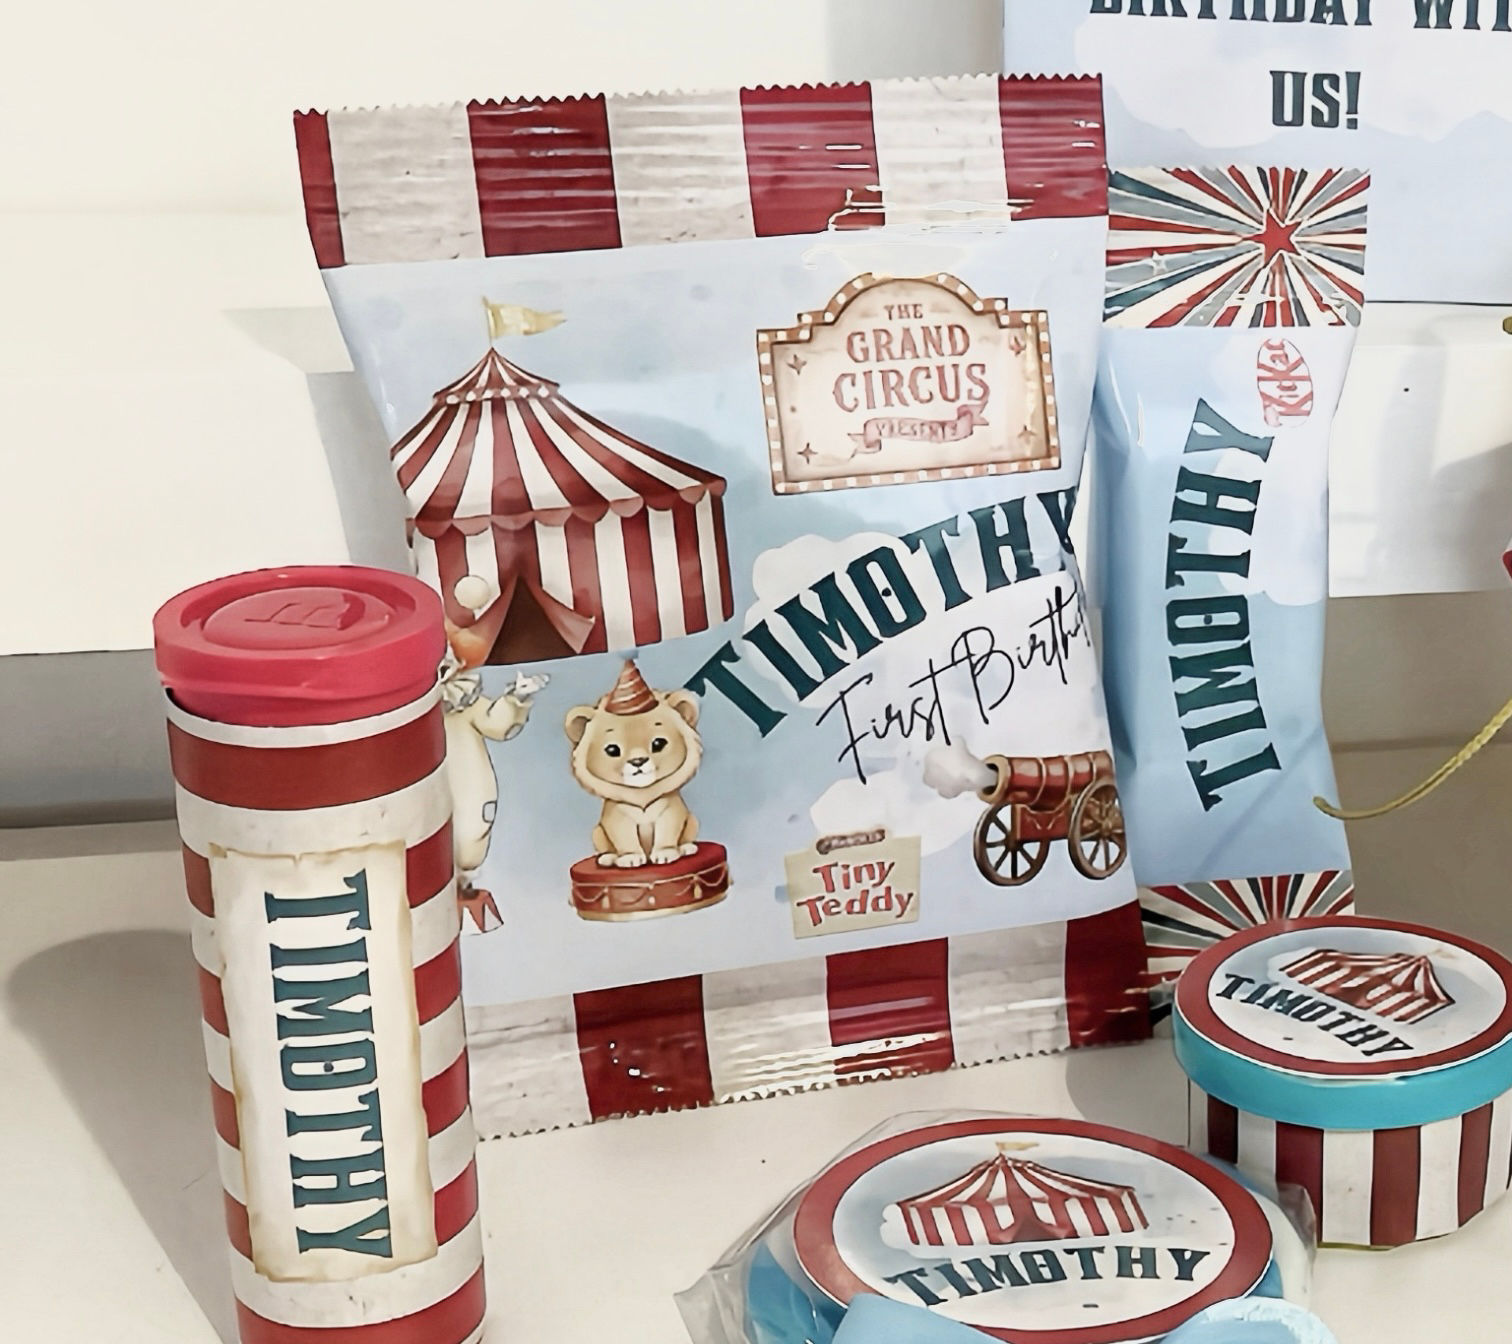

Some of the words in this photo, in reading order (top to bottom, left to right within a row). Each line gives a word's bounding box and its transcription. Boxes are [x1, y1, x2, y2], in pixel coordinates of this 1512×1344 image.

[1268, 69, 1361, 130] US!
[883, 303, 924, 321] THE
[846, 323, 971, 364] GRAND
[832, 362, 991, 413] CIRCUS
[683, 486, 1077, 738] TIMOTHY
[1165, 397, 1282, 812] TIMOTHY
[816, 654, 972, 785] First
[796, 886, 914, 927] Teddy
[812, 861, 896, 894] Tiny
[1215, 972, 1415, 1057] TIMOTHY
[263, 867, 393, 1259] TIMOTHY
[881, 1244, 1213, 1308] TIMOTHY
